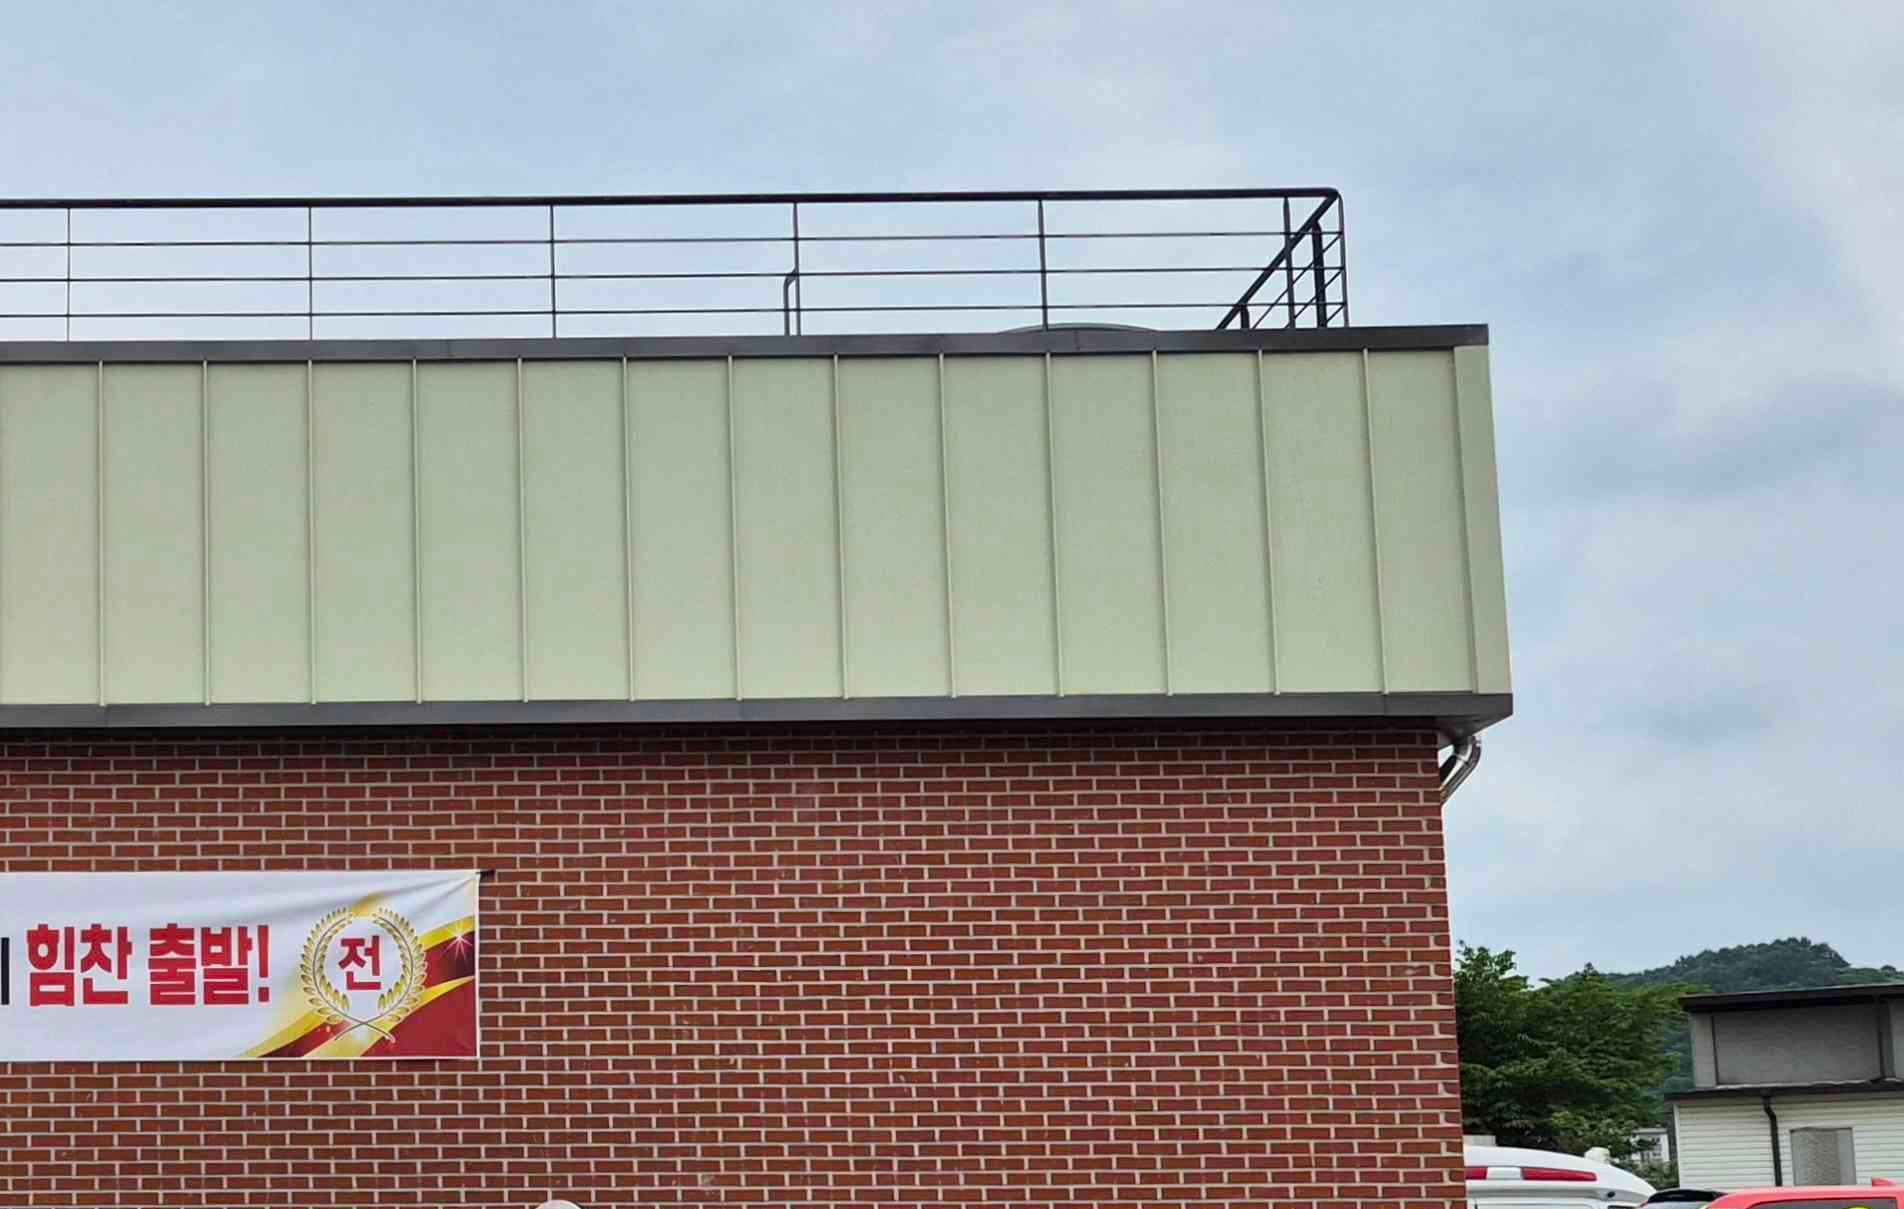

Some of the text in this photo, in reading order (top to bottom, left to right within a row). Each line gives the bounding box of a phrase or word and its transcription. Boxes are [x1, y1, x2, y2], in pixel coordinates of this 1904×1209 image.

[26, 923, 132, 1007] 힘찬
[147, 923, 270, 1007] 출발!
[338, 936, 382, 991] 전
